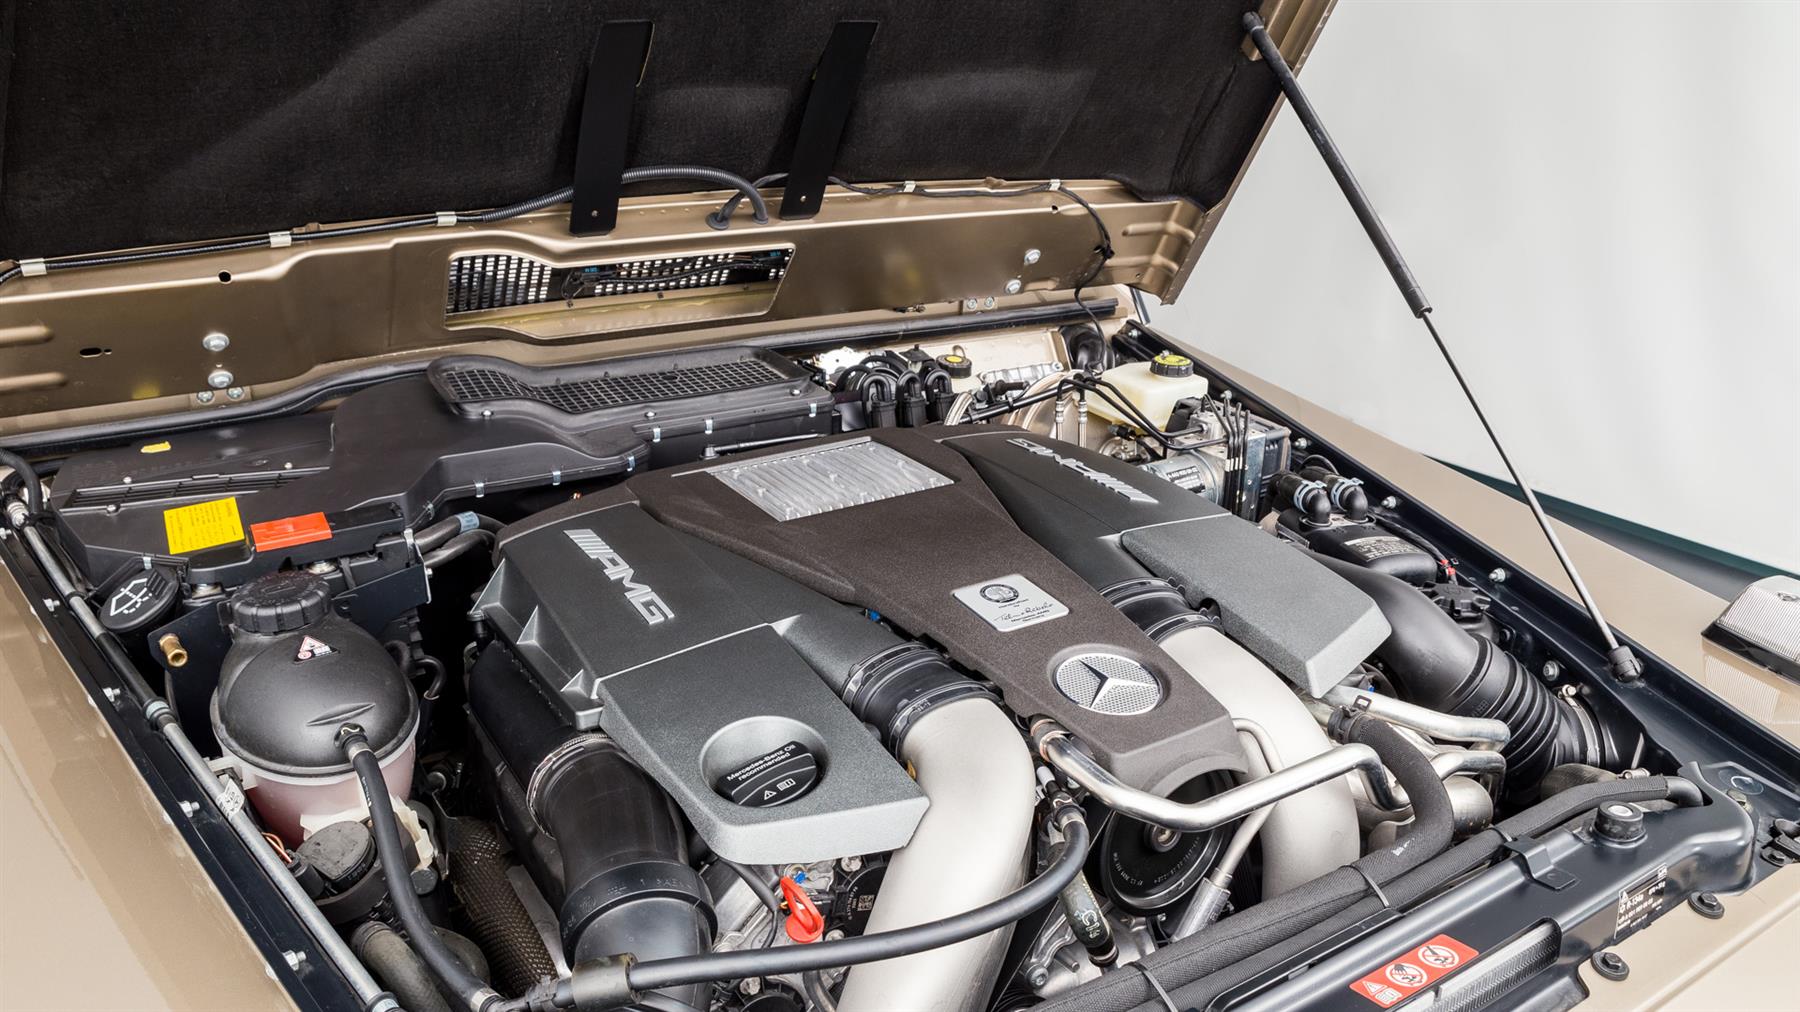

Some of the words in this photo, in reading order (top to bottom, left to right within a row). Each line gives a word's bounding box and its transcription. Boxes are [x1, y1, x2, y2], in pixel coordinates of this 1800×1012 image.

[594, 551, 675, 625] AMG
[726, 750, 784, 781] Mercedes-Benz
[738, 752, 791, 781] recommended
